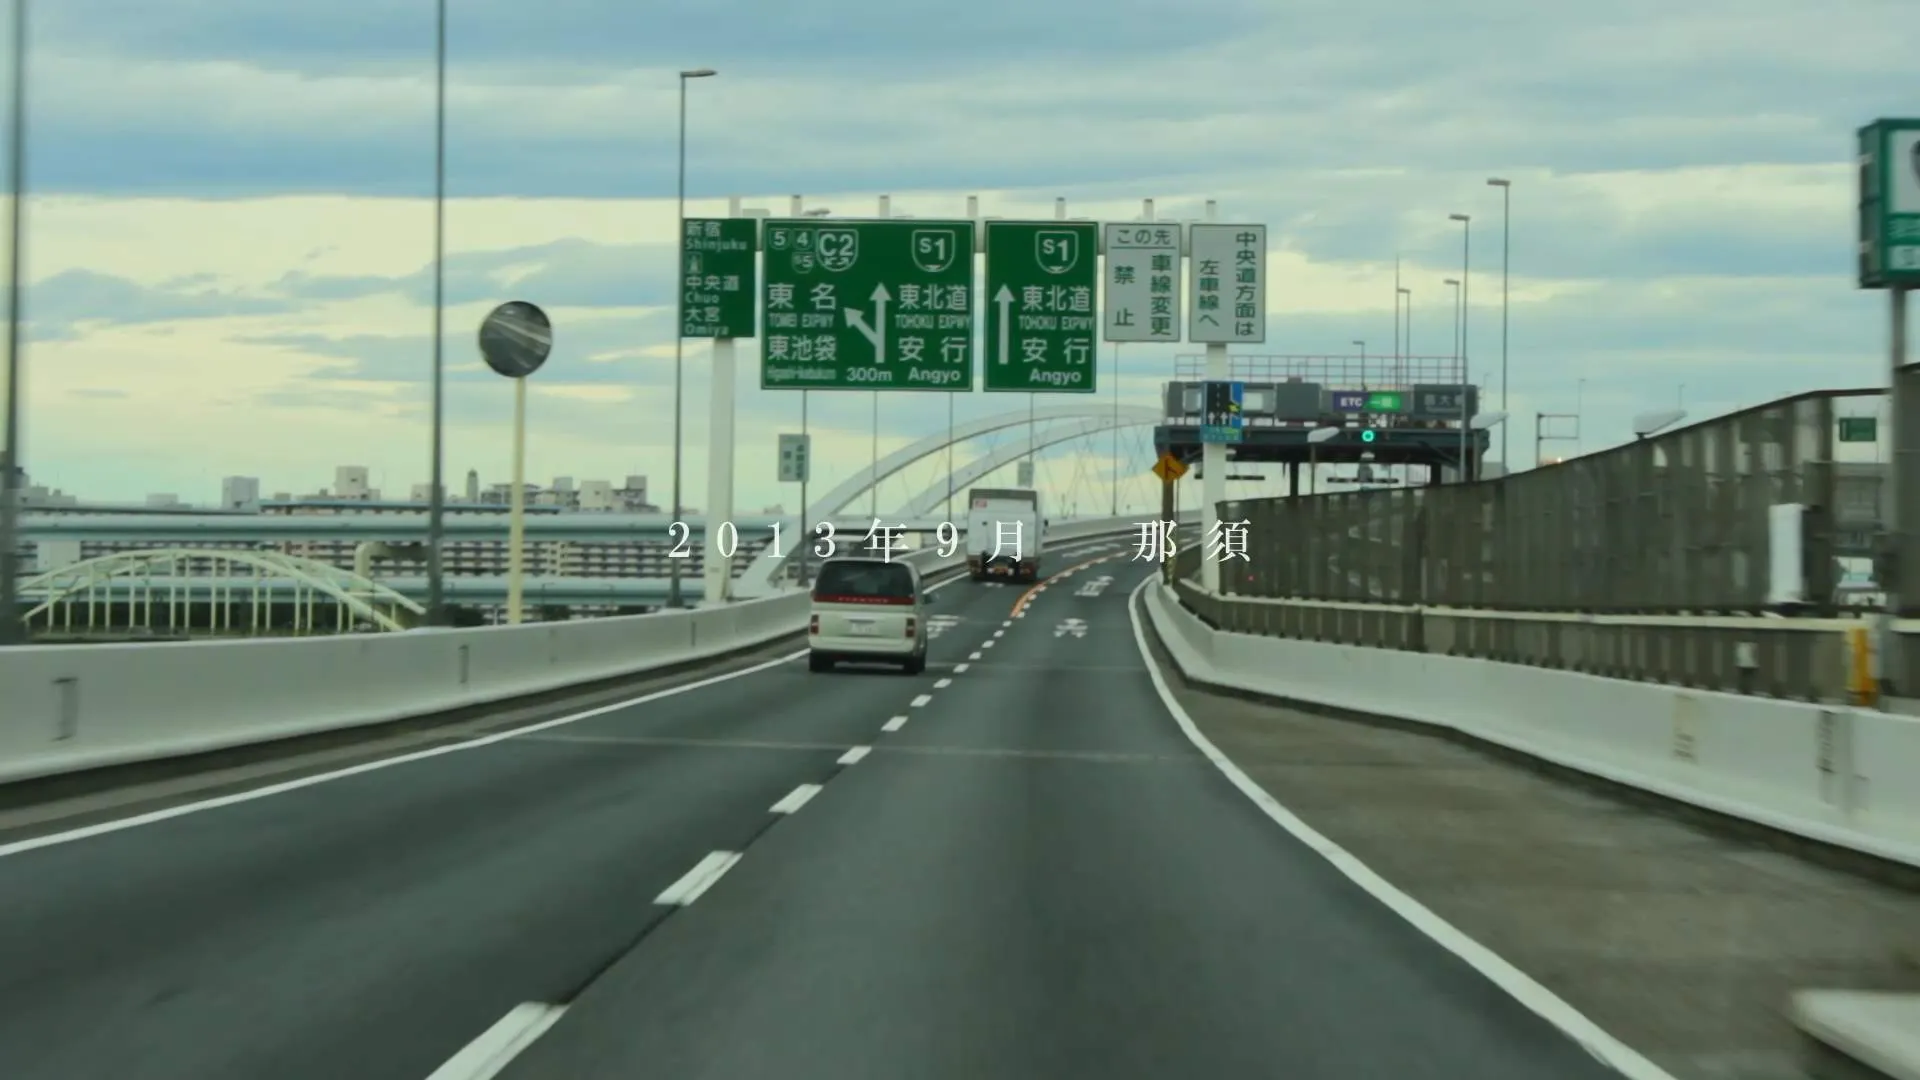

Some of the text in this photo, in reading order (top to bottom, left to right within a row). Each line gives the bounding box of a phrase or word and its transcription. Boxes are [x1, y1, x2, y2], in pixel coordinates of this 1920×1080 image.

[686, 221, 721, 237] 新宿
[1117, 229, 1171, 245] この先
[685, 238, 747, 252] Shinjuku
[774, 231, 808, 246] 5 4
[819, 233, 854, 256] C2
[919, 238, 946, 261] S1
[1042, 239, 1068, 262] S1
[685, 275, 739, 291] 中央道
[1235, 231, 1256, 336] 中央道方面は
[685, 291, 720, 304] Chuo
[768, 283, 837, 310] 東名
[898, 284, 968, 311] 東北道
[1022, 285, 1091, 312] 東北道
[1113, 265, 1135, 327] 禁止
[1150, 254, 1172, 336] 車線変更
[1198, 259, 1220, 328] 左車線へ
[685, 306, 721, 322] 大宮
[895, 314, 934, 329] TOHOKU
[1019, 315, 1058, 331] TOHOKU
[685, 324, 729, 337] Omiya
[768, 335, 837, 362] 東池袋
[898, 336, 968, 363] 安行
[1022, 337, 1090, 364] 安行
[846, 367, 893, 382] 300m
[908, 367, 961, 384] Angyo
[1029, 368, 1082, 386] Angyo
[1340, 397, 1363, 407] ETC
